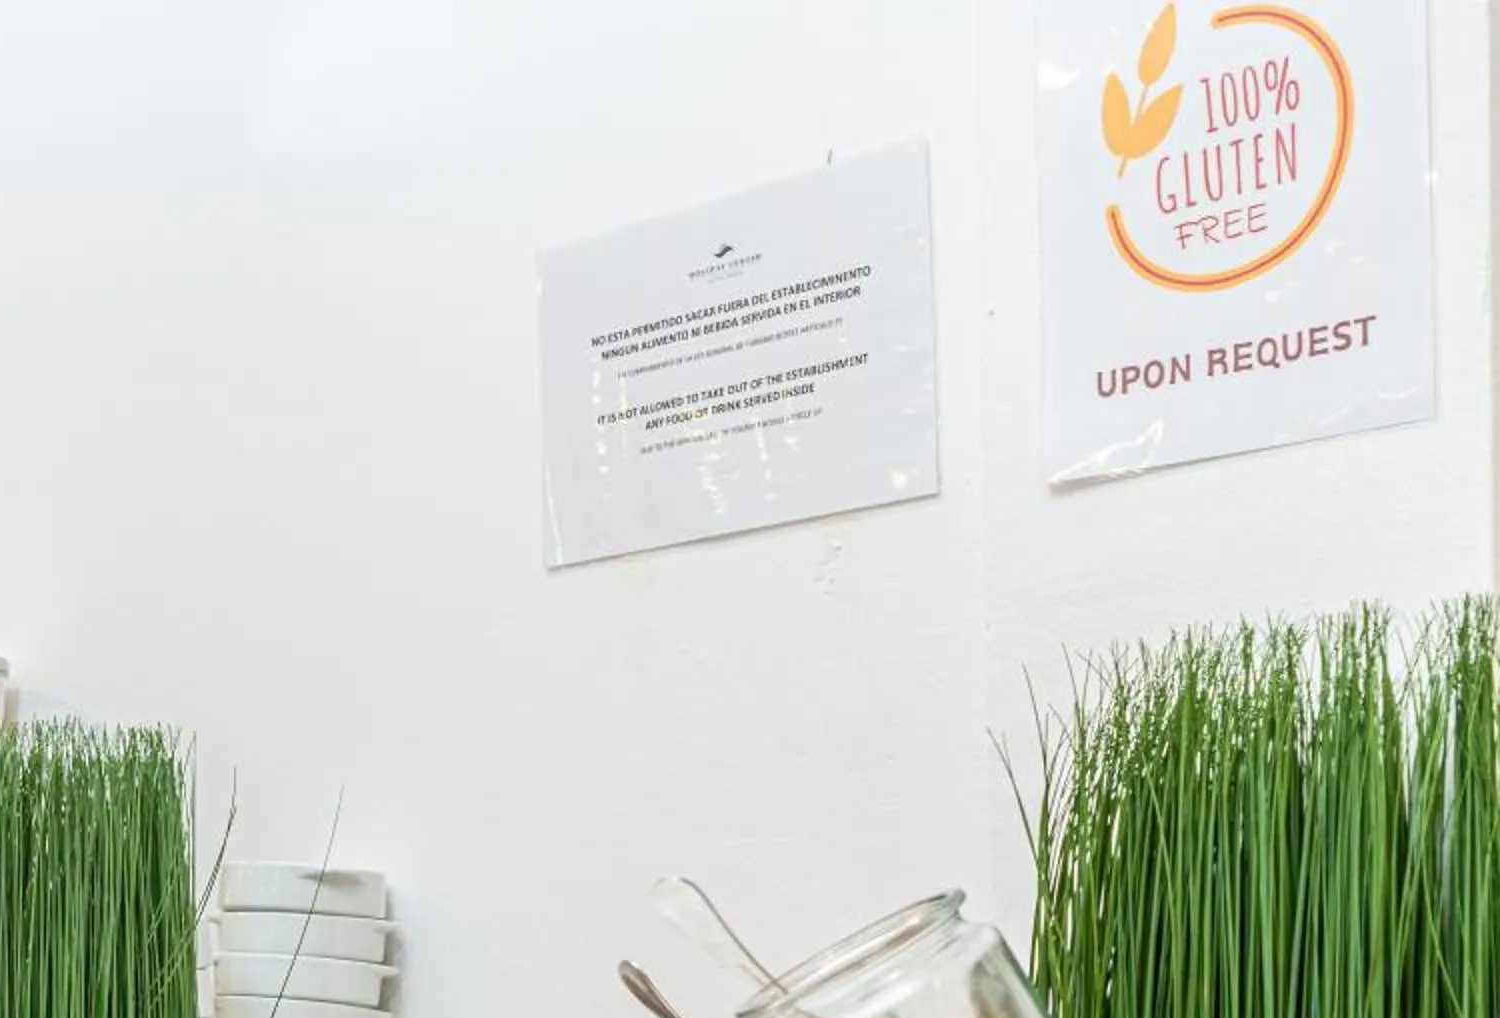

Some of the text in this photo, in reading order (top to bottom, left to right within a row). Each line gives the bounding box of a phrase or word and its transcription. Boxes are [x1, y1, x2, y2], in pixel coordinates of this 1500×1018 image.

[1199, 56, 1301, 133] 100%
[1155, 122, 1297, 215] GLUTEN
[1173, 203, 1268, 249] FREE
[591, 335, 607, 347] NO
[632, 315, 683, 337] PERMITIDO
[684, 306, 717, 322] SACAR
[717, 298, 750, 314] FUERA
[751, 293, 770, 306] DEL
[640, 329, 689, 351] ALIMENTO
[691, 326, 702, 338] NI
[703, 317, 739, 335] BEBIDA
[741, 306, 782, 326] SERVIDA
[783, 302, 797, 314] EN
[799, 299, 811, 311] EL
[813, 285, 861, 307] INTERIOR
[597, 352, 869, 425] IT IS NOT ALLOWED TO TAKE OUT OF THE ESTABLISHMENT
[1096, 315, 1377, 398] UPON REQUEST
[645, 417, 665, 430] ANY
[666, 410, 693, 425] FOOD
[711, 399, 741, 416] DRINK
[743, 390, 781, 409] SERVED
[782, 381, 815, 400] INSIDE
